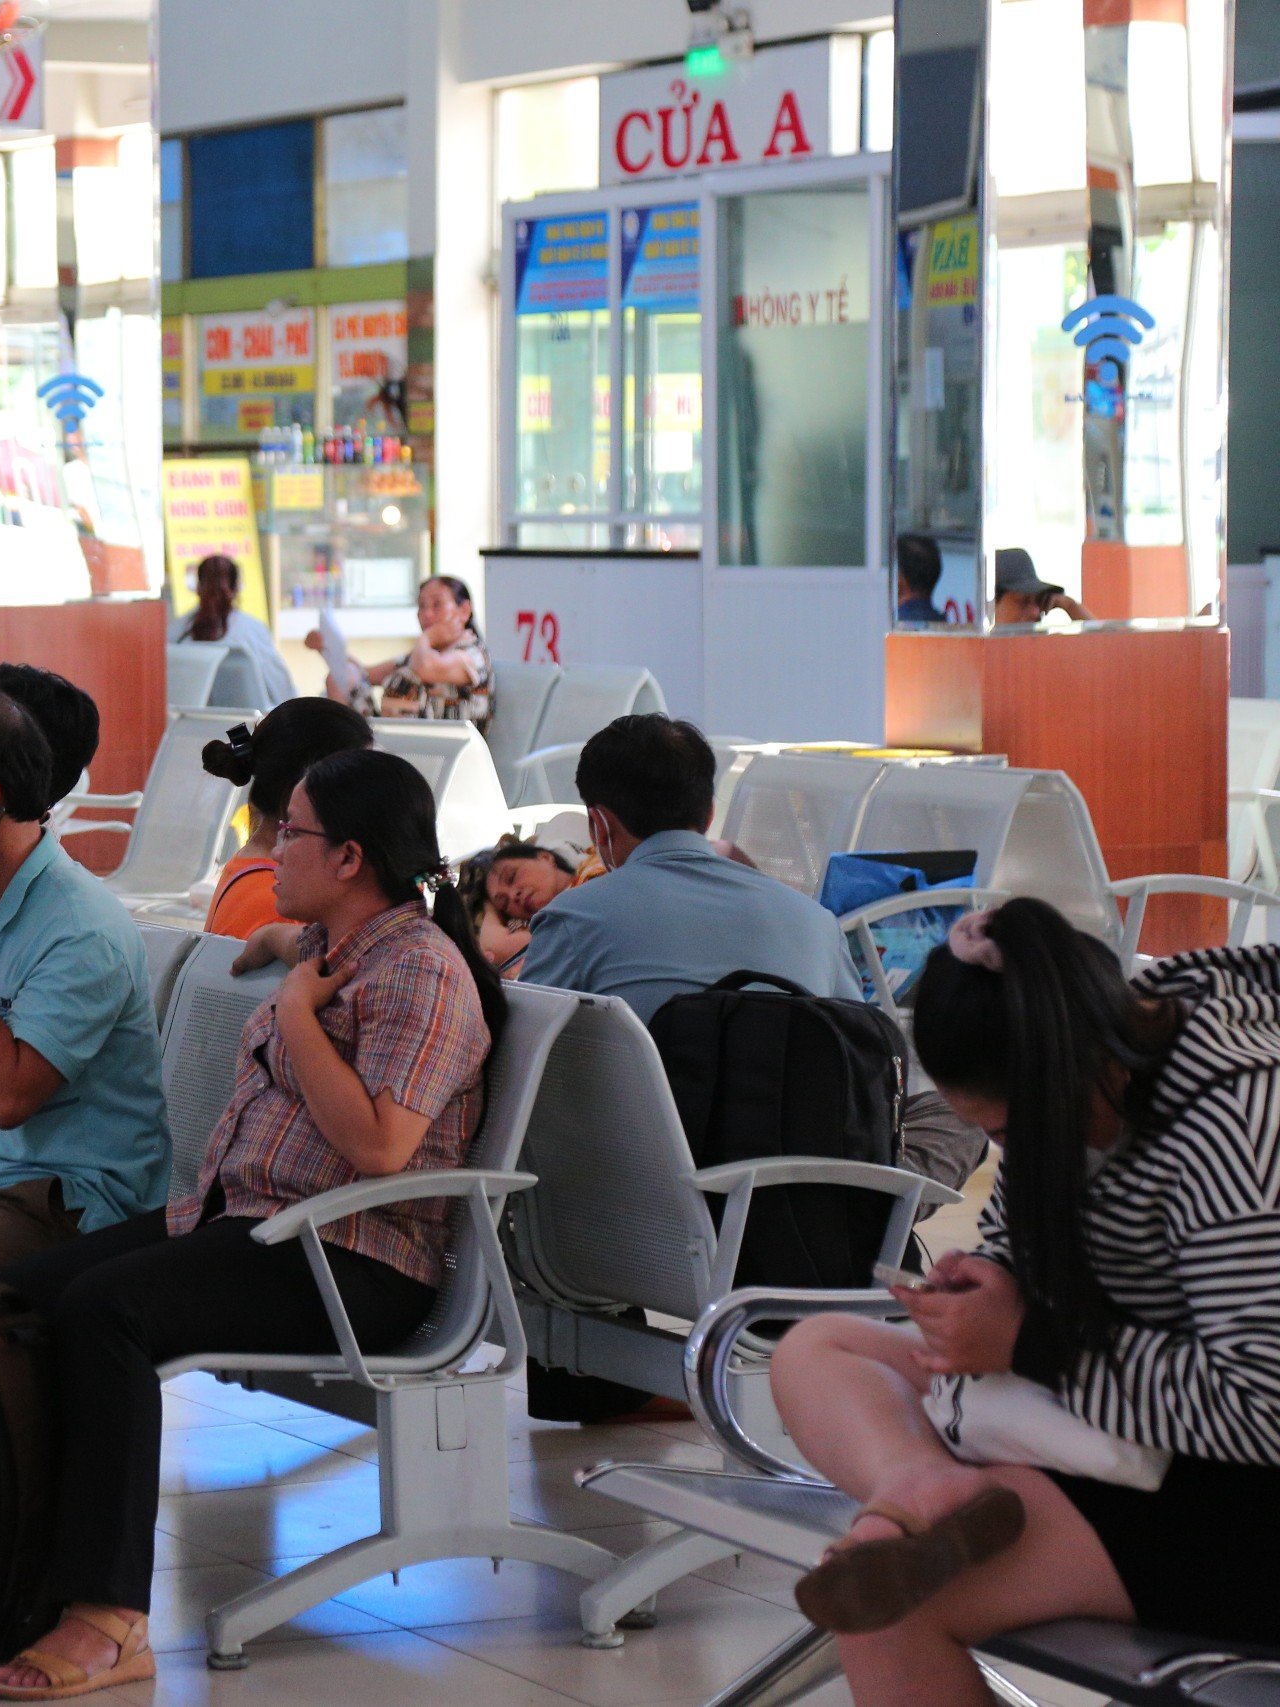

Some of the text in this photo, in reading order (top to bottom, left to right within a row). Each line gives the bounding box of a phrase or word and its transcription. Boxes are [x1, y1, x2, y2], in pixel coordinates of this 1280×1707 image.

[614, 79, 814, 174] CỬA A
[806, 290, 820, 325] Y
[824, 274, 848, 323] TẾ
[516, 611, 559, 665] 73
